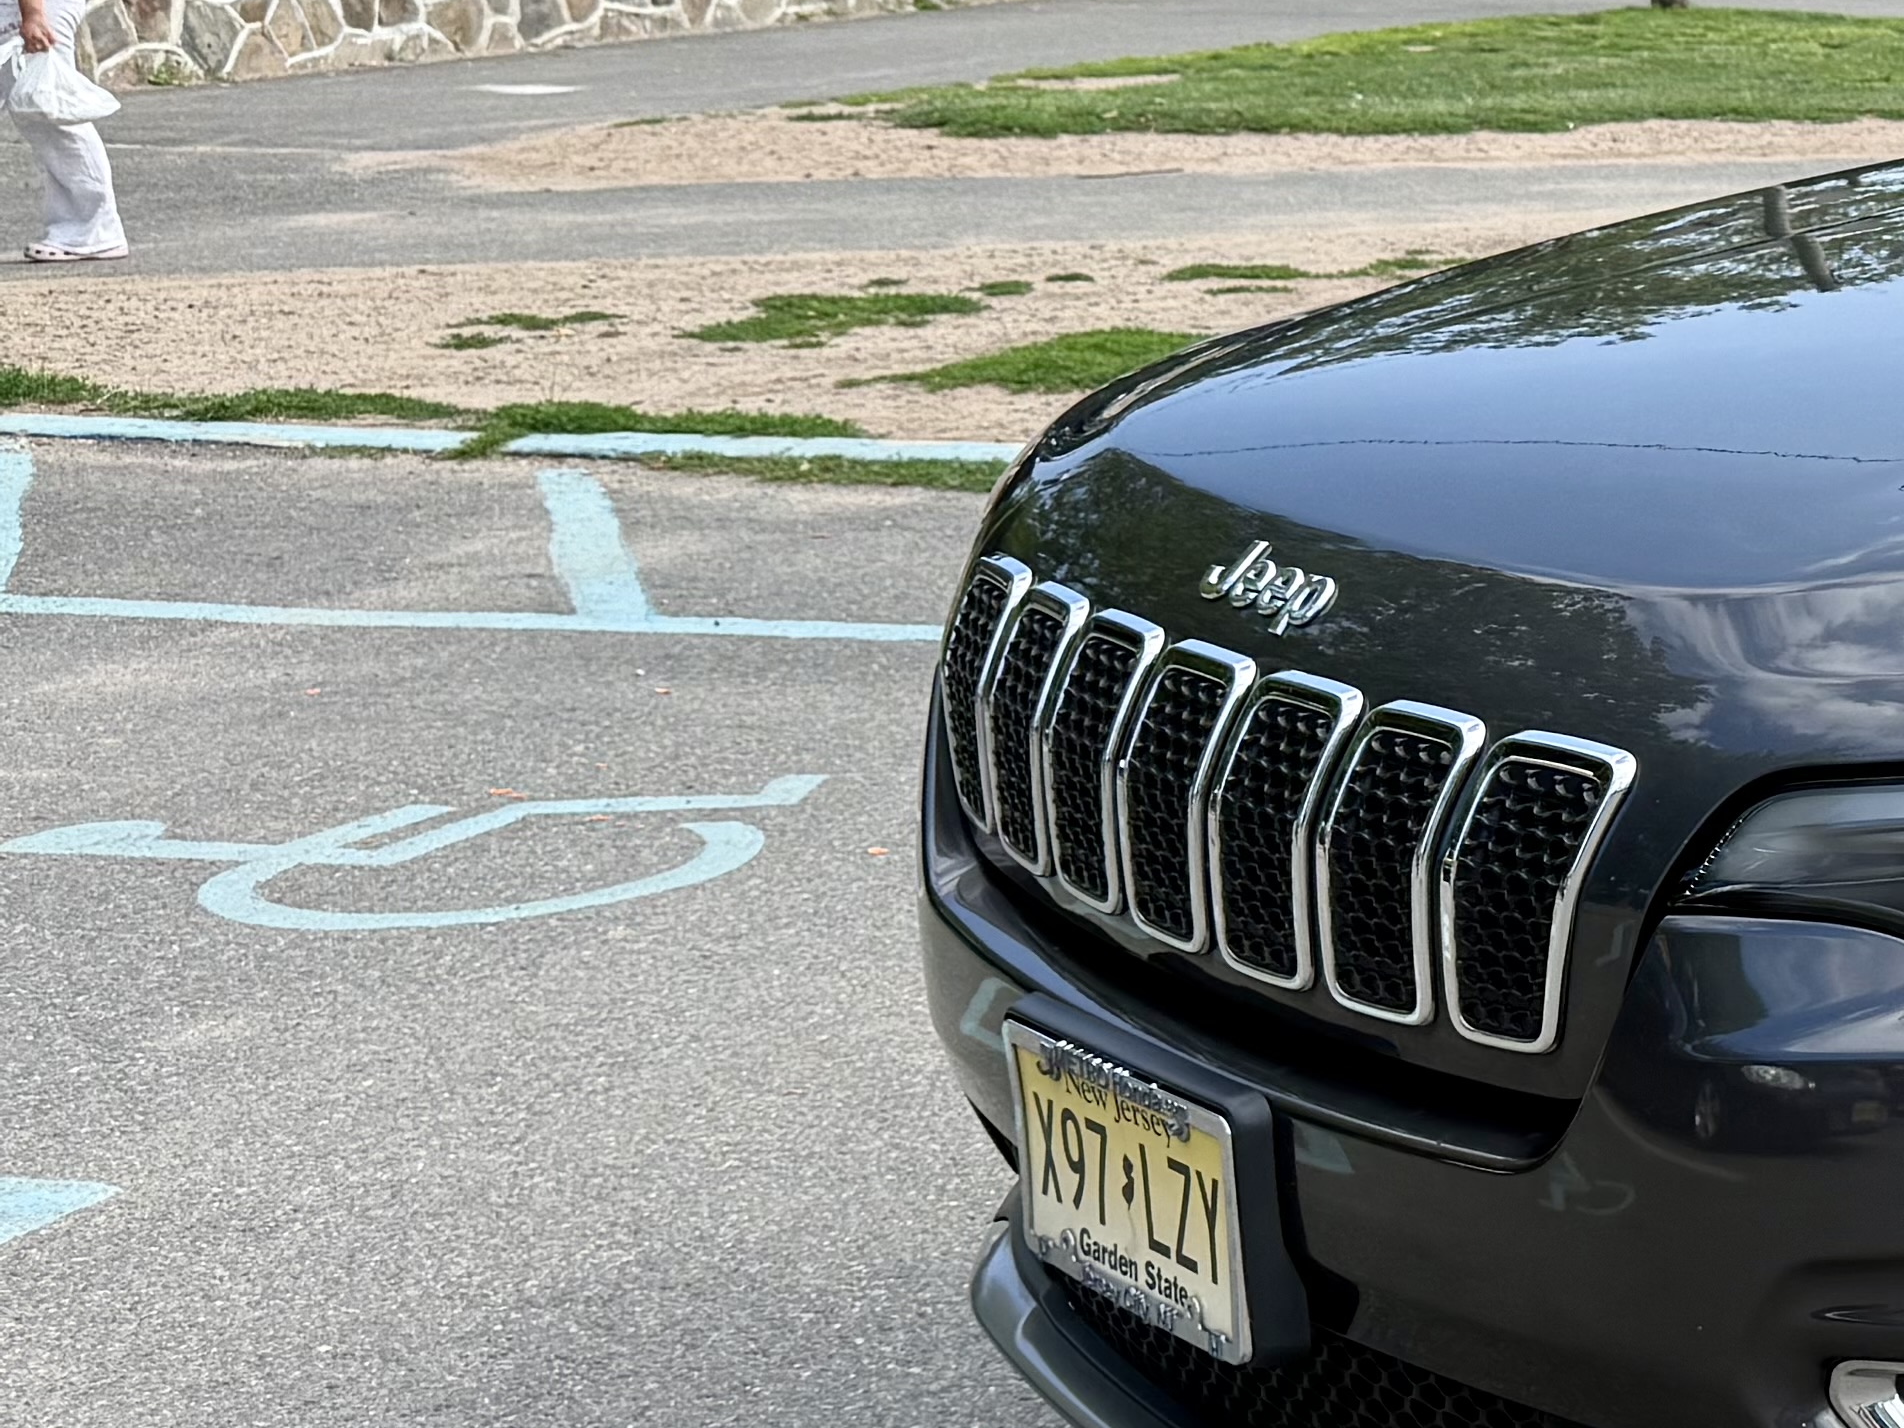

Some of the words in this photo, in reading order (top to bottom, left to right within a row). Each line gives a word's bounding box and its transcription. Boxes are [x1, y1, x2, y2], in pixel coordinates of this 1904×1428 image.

[1200, 540, 1339, 637] Jeep
[1065, 1071, 1108, 1111] New
[1113, 1085, 1171, 1149] Jersey
[1033, 1091, 1106, 1225] X97
[1138, 1143, 1219, 1285] LZY
[1080, 1227, 1138, 1282] Garden
[1145, 1260, 1188, 1308] State
